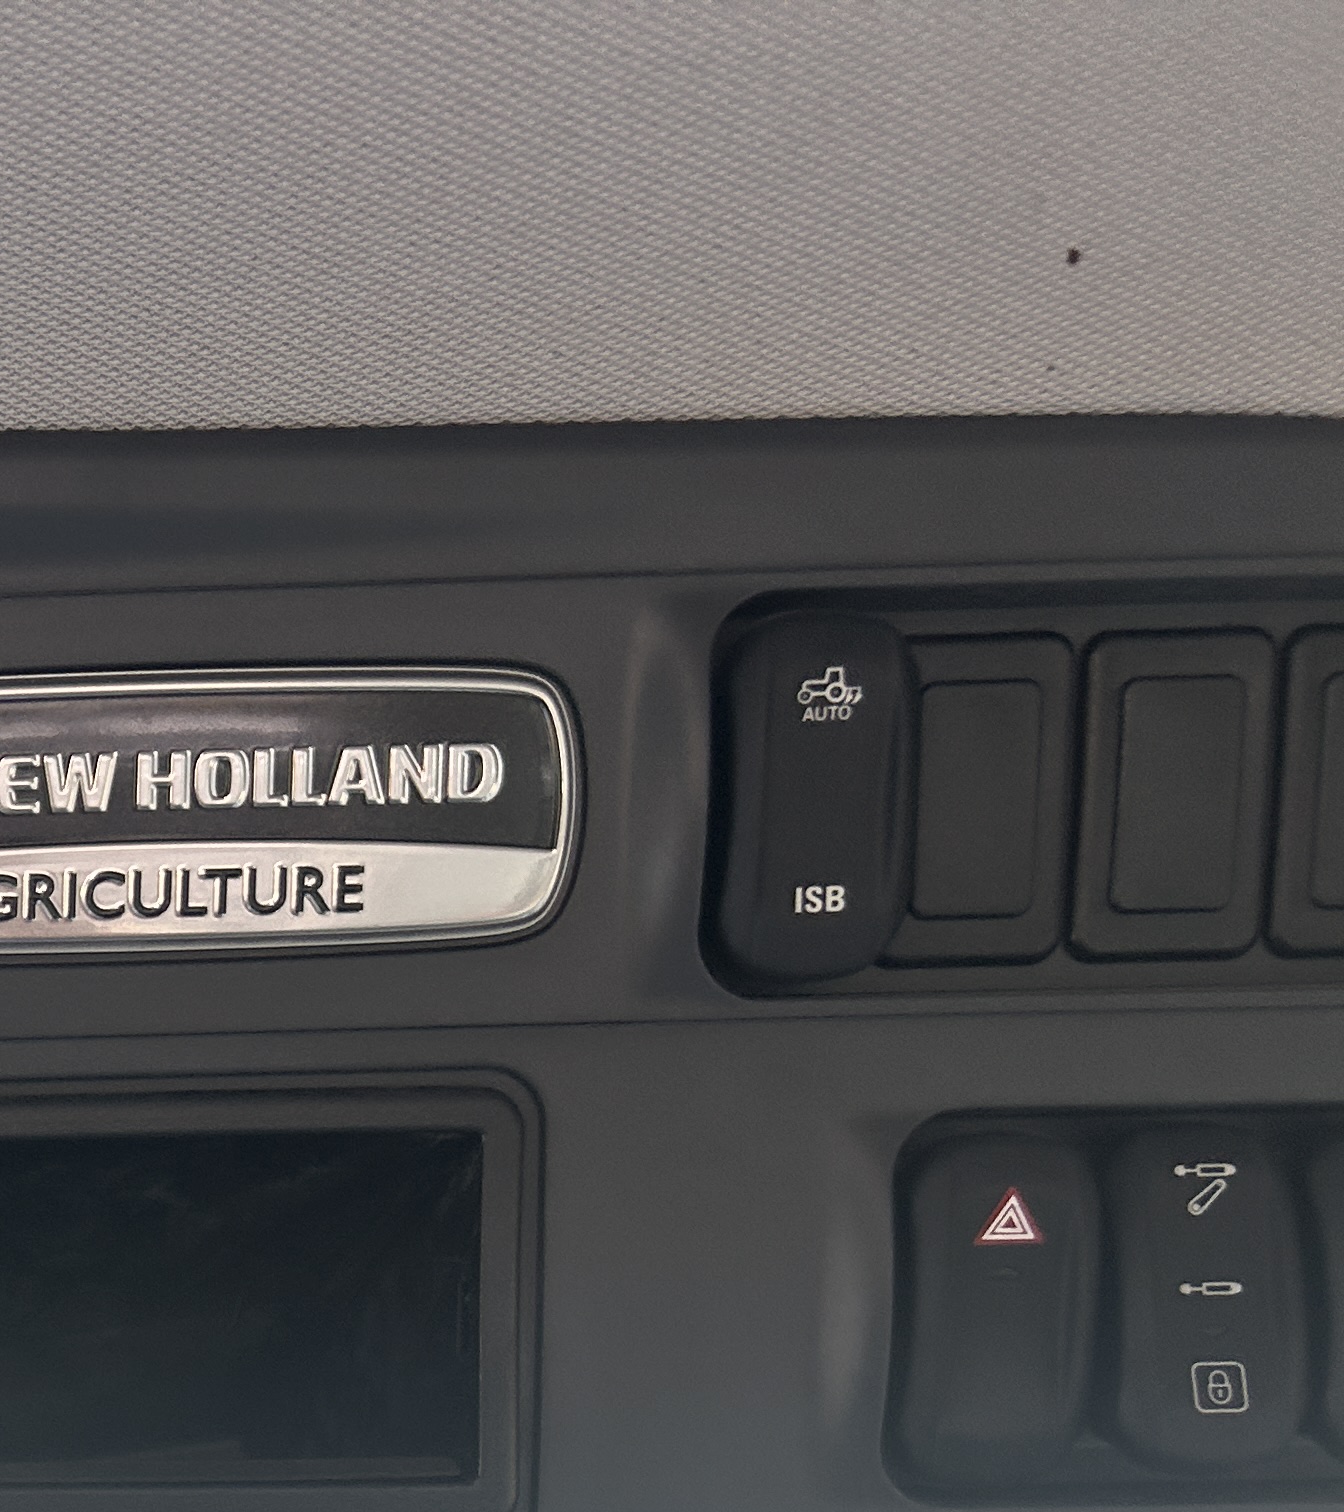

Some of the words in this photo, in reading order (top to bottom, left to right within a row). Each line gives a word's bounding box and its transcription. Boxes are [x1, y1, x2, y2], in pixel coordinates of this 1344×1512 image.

[801, 705, 854, 722] AUTO
[134, 740, 507, 814] HOLLAND
[793, 884, 846, 914] ISB
